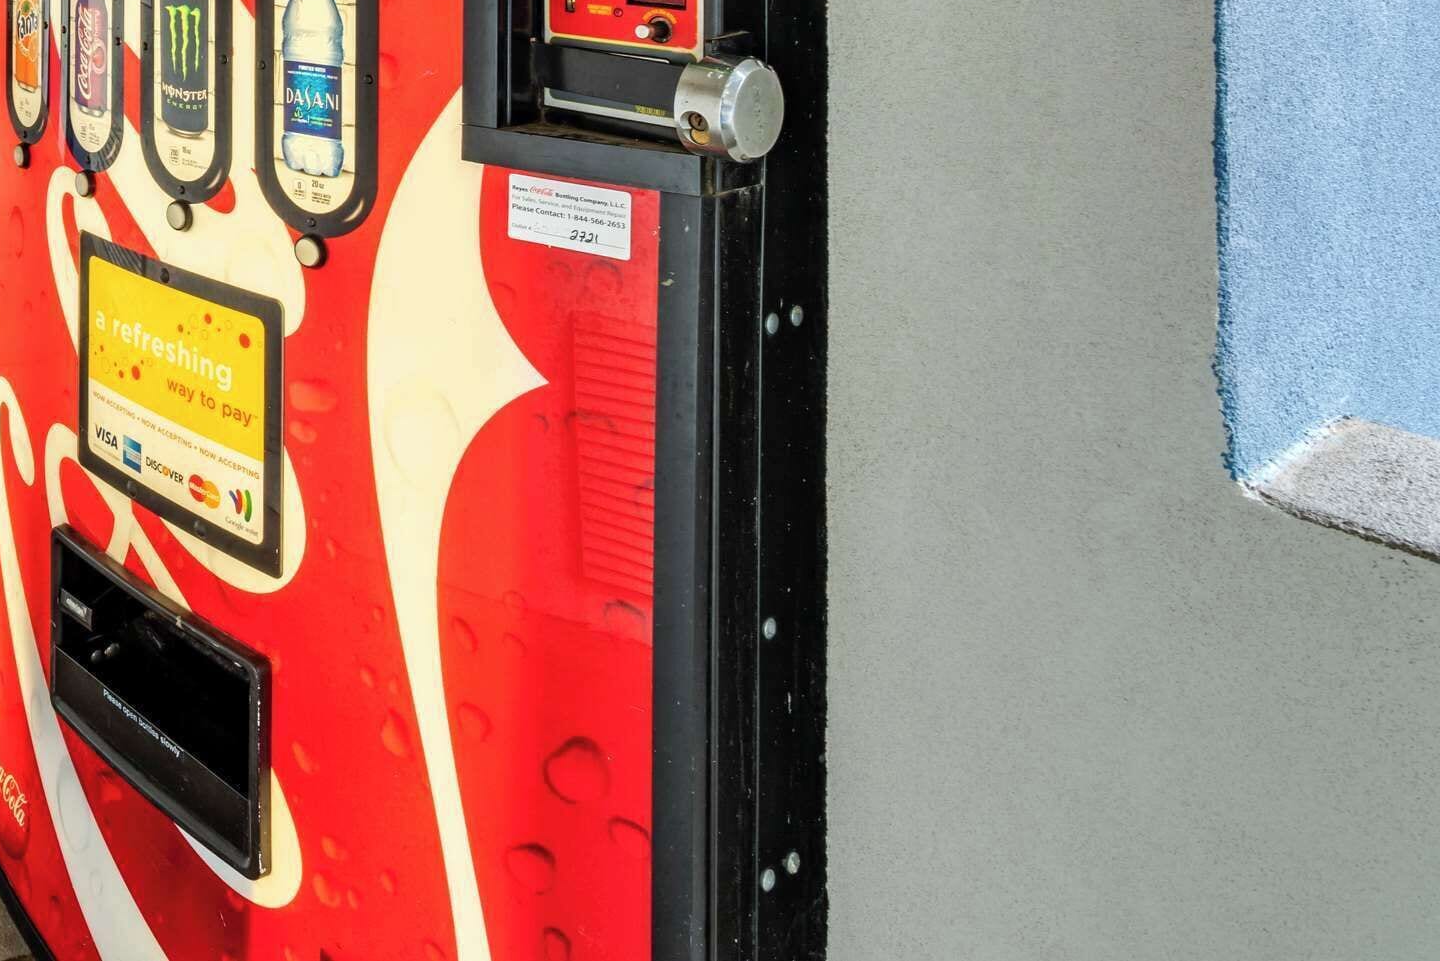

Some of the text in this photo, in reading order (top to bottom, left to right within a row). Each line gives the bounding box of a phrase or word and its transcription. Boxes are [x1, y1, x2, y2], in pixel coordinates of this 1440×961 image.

[162, 81, 208, 102] MONSTER
[286, 85, 339, 112] DASANI
[555, 192, 579, 202] Bottling
[579, 196, 608, 207] Company,
[573, 204, 606, 216] Equipment
[512, 203, 626, 229] Please Contact: 1-844-566-2653
[96, 310, 232, 392] a refreshing
[167, 377, 195, 403] way
[200, 391, 215, 410] to
[93, 392, 260, 480] NOW ACCEPTING NOW ACCEPTING NOW ACCEPTING
[94, 423, 119, 450] VISA
[145, 456, 184, 486] DISCOVER
[225, 516, 244, 530] Google
[103, 688, 181, 758] Please open bottles slowly
